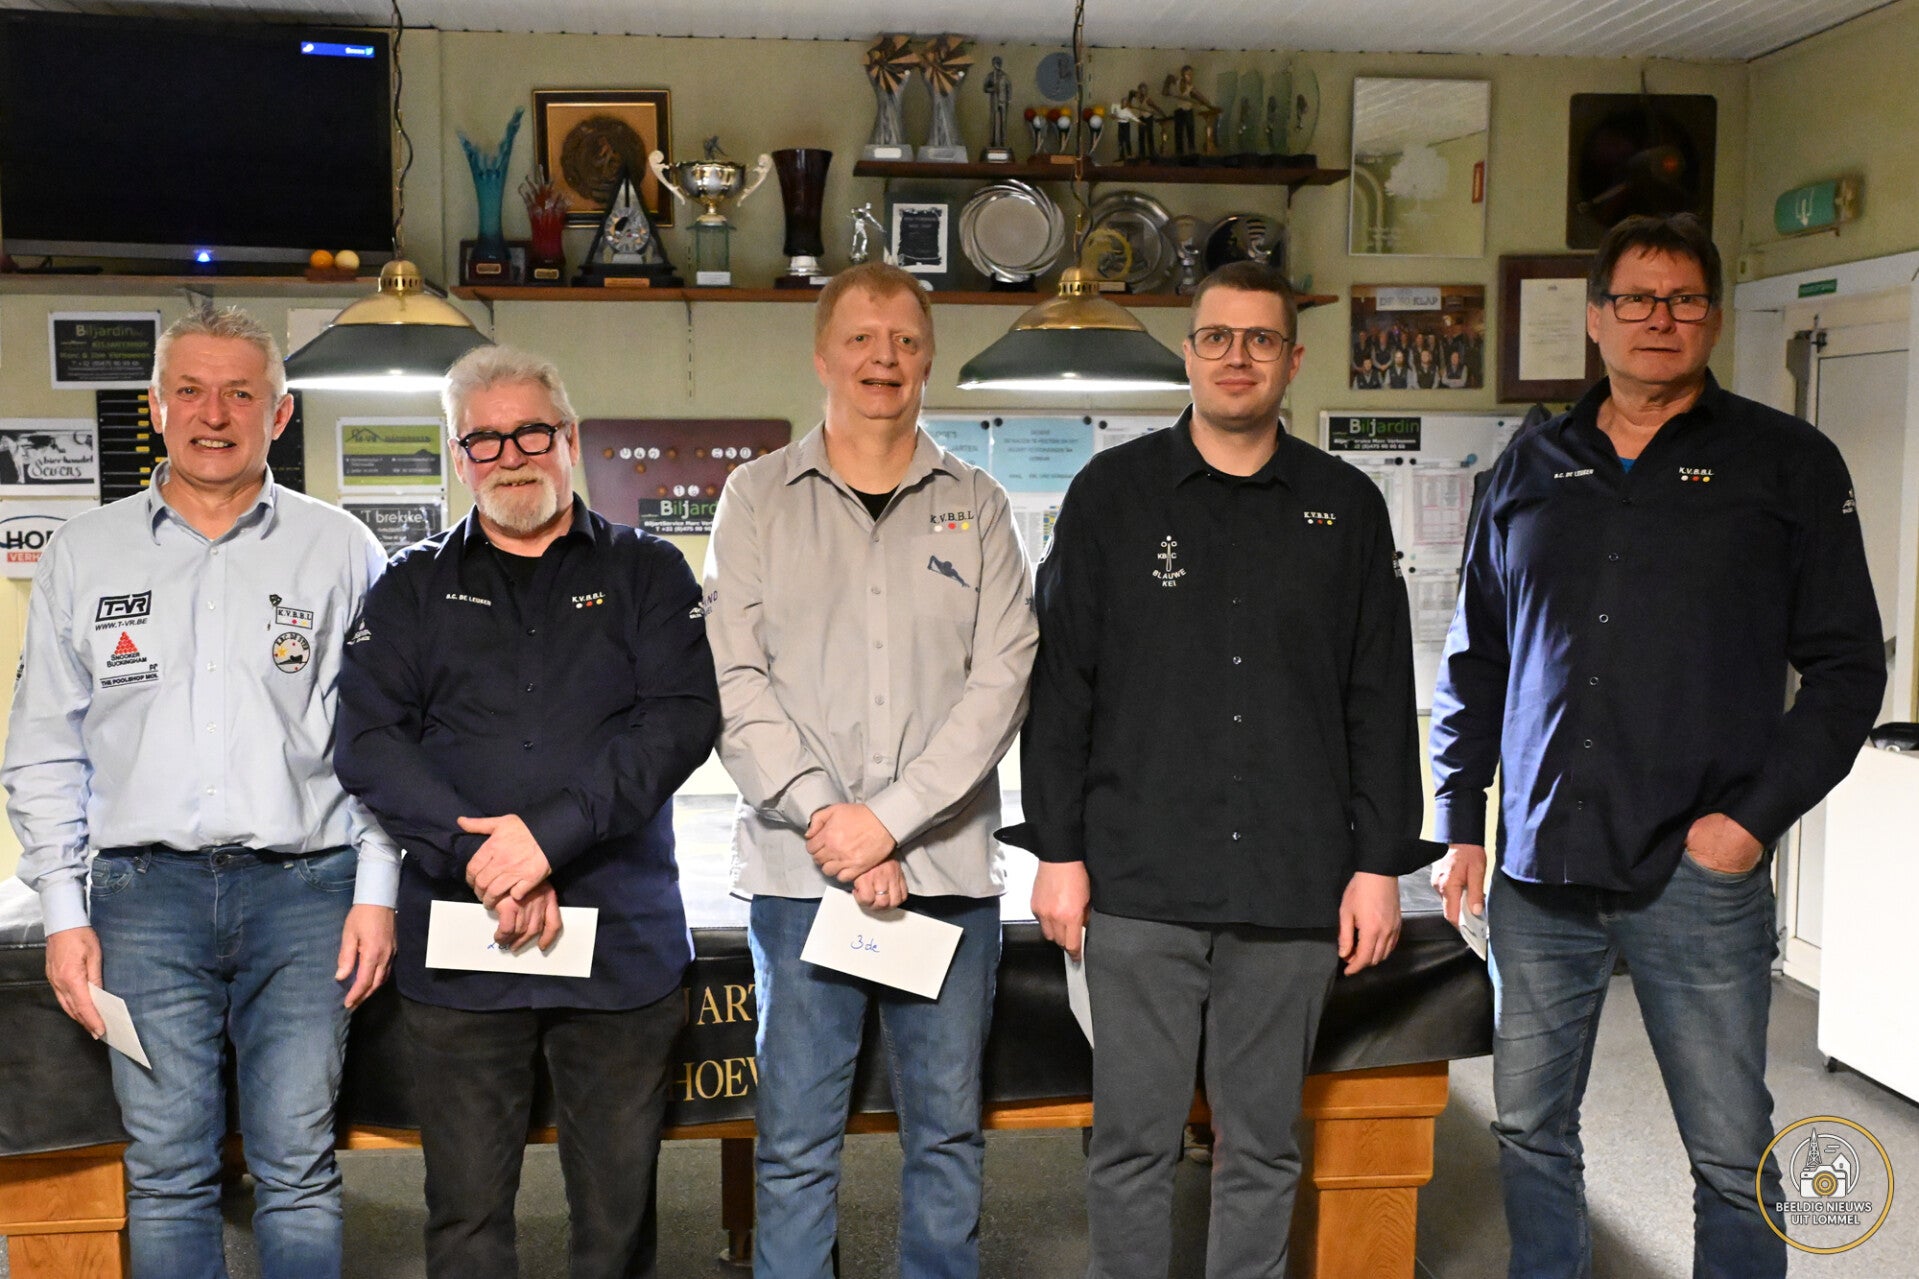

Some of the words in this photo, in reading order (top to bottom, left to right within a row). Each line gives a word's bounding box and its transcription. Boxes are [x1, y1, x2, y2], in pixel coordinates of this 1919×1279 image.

[1350, 418, 1419, 437] Biljardin
[375, 511, 423, 523] brekske
[1152, 568, 1187, 580] BLAUWE
[104, 597, 147, 616] T-VR
[95, 617, 148, 631] WWW.T-VR.BE
[106, 657, 147, 668] BUCKINGHAM
